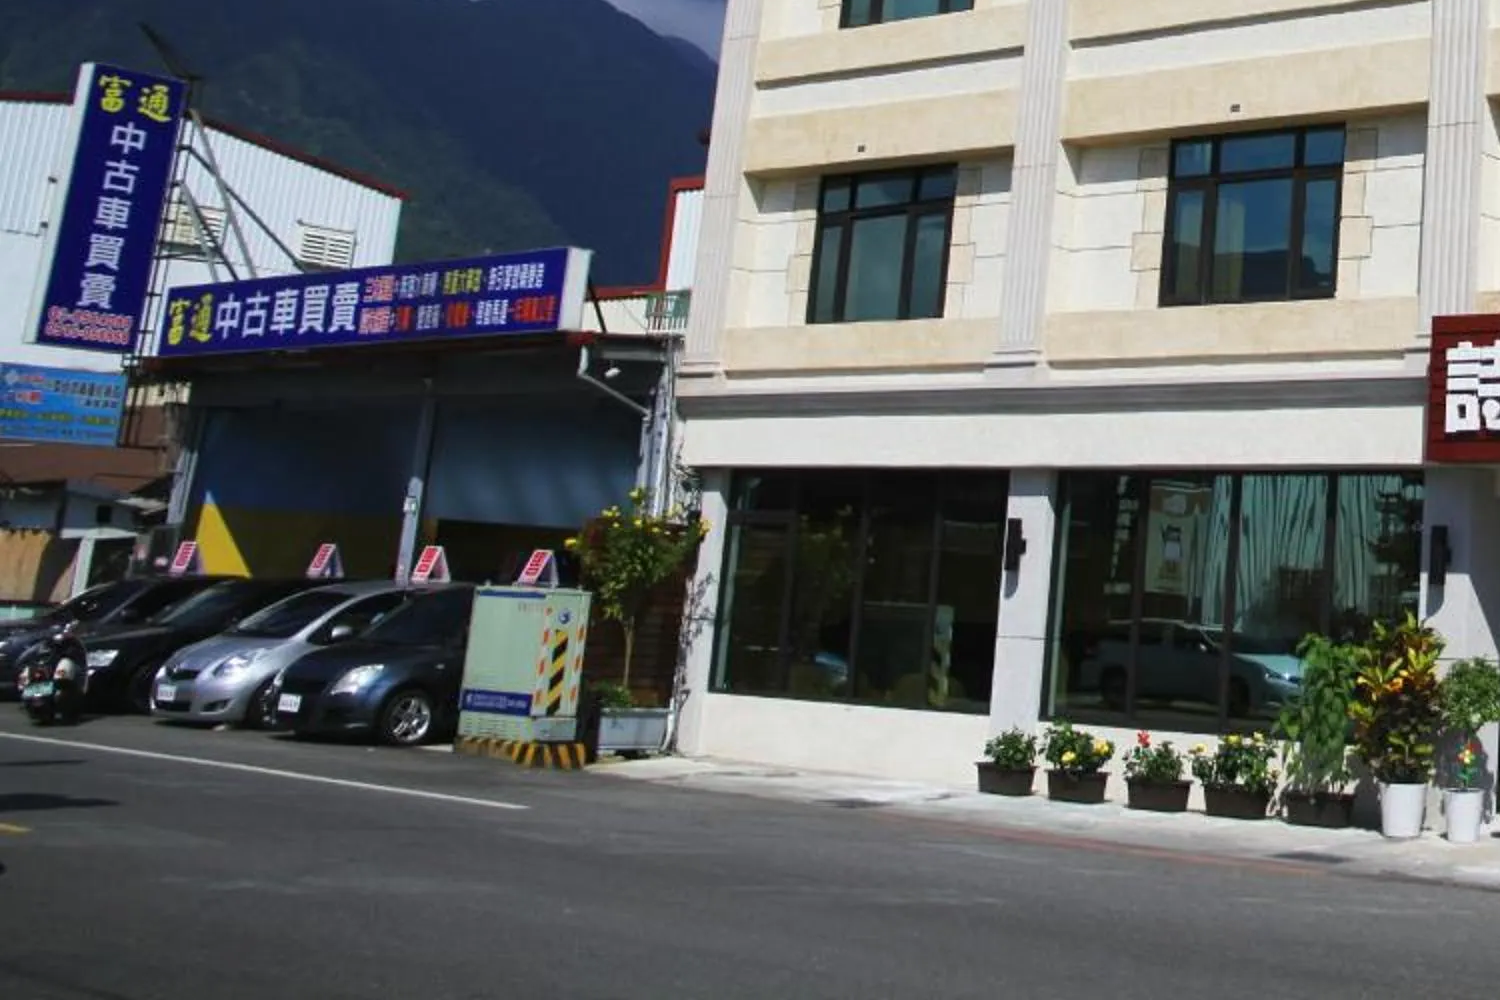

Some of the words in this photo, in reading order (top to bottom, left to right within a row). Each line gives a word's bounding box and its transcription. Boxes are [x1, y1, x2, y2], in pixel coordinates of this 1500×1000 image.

[99, 75, 172, 122] 富通
[77, 121, 147, 309] 中古車買賣
[168, 293, 213, 345] 富通
[215, 282, 360, 340] 中古車買賣
